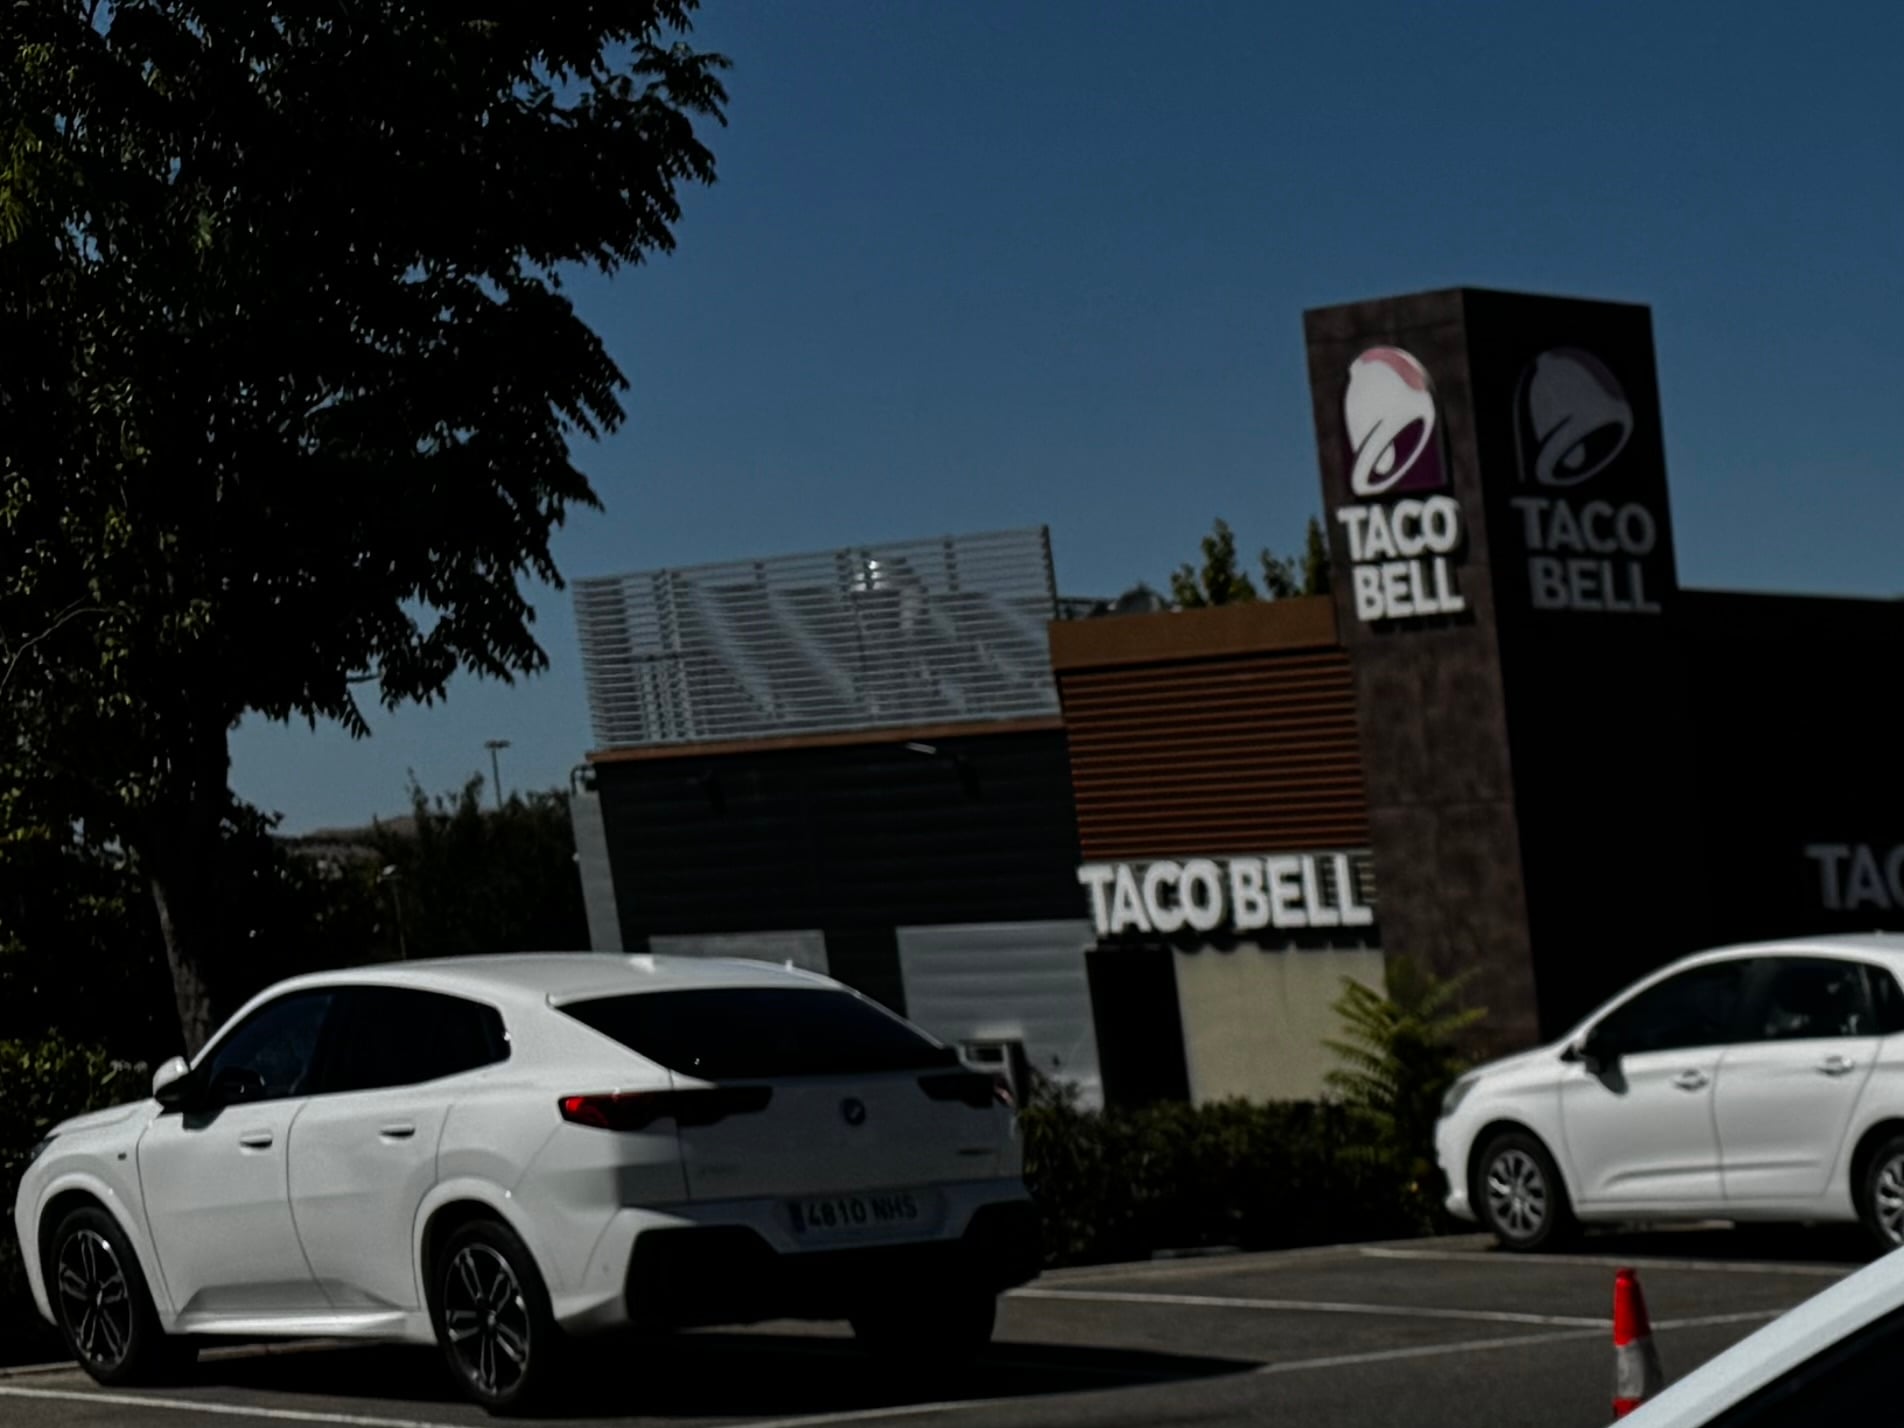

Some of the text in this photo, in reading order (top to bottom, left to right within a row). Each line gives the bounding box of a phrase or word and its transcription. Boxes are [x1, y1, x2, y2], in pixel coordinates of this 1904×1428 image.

[1336, 494, 1464, 563] TACO
[1508, 496, 1658, 556] TACO
[1353, 556, 1466, 622] BELL
[1527, 555, 1664, 616] BELL
[1076, 852, 1374, 936] TACO BELL
[808, 1198, 868, 1227] 4810
